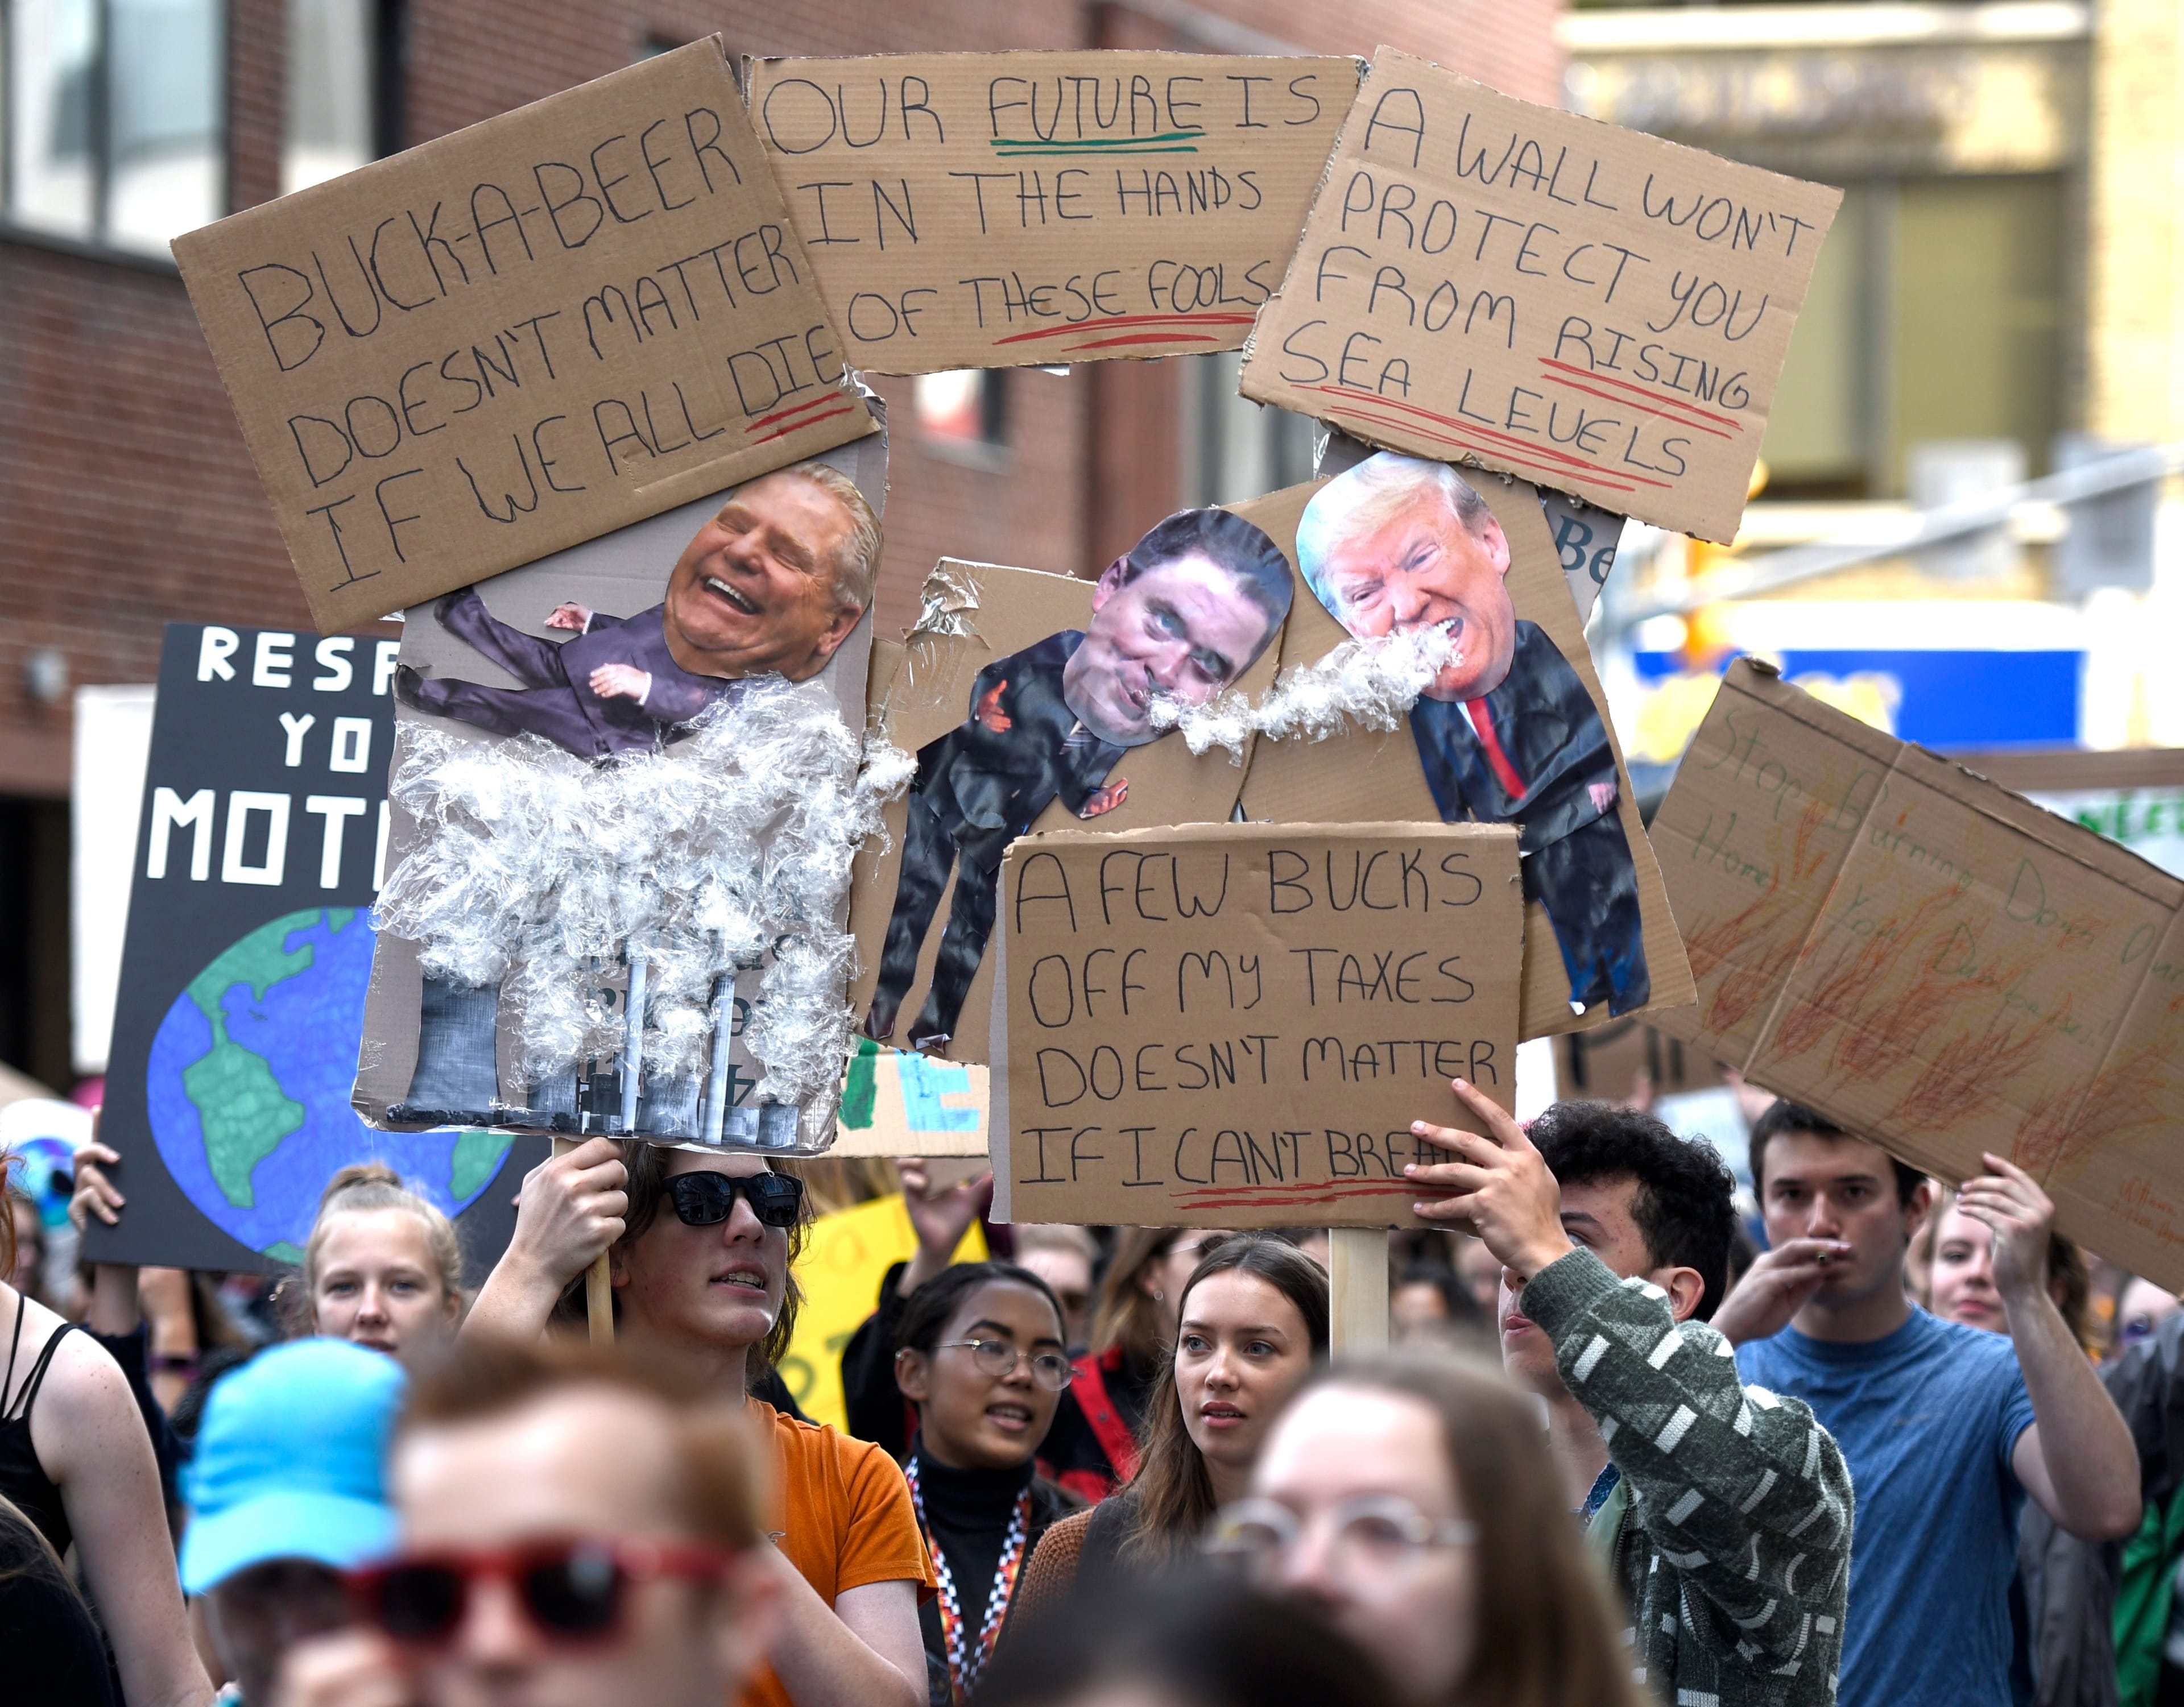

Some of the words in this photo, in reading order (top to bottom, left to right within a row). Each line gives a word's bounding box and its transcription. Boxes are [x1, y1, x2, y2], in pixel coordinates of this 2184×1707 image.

[763, 77, 944, 154] OUR
[989, 76, 1204, 141] FUTURE
[1226, 75, 1321, 128] IS
[797, 179, 919, 250] IN
[948, 169, 1094, 234] THE
[1116, 165, 1262, 217] HANDS
[1363, 88, 1425, 168] A
[1456, 113, 1618, 211] WALL
[1643, 173, 1815, 256] WON'T
[238, 107, 742, 372] BUCK-A-BEER
[1341, 171, 1651, 303] PROTECT
[1648, 271, 1769, 341] YOU
[848, 288, 937, 342] OF
[959, 270, 1127, 329] THESE
[1147, 259, 1272, 312] FOOLS
[1316, 245, 1515, 349] FROM
[1554, 316, 1751, 409] RISING
[288, 312, 561, 487] DOESN'T
[584, 225, 799, 359] MATTER
[1279, 319, 1411, 397] SEA
[307, 469, 425, 591] IF
[456, 415, 585, 523] WE
[594, 382, 726, 475] ALL
[728, 325, 842, 416] DIE
[1703, 709, 1802, 821] Stop
[1823, 769, 1974, 889] Burning
[1016, 851, 1076, 934] A
[1100, 850, 1229, 925] FEW
[1268, 848, 1482, 913] BUCKS
[1691, 811, 1769, 887] Home
[1029, 948, 1147, 1028] OFF
[1179, 950, 1261, 1012] MY
[1289, 948, 1474, 1006] TAXES
[1037, 1035, 1280, 1108] DOESN'T
[1304, 1037, 1498, 1084] MATTER
[1020, 1126, 1105, 1184] IF
[1118, 1126, 1164, 1187] I
[1173, 1128, 1312, 1186] CAN'T
